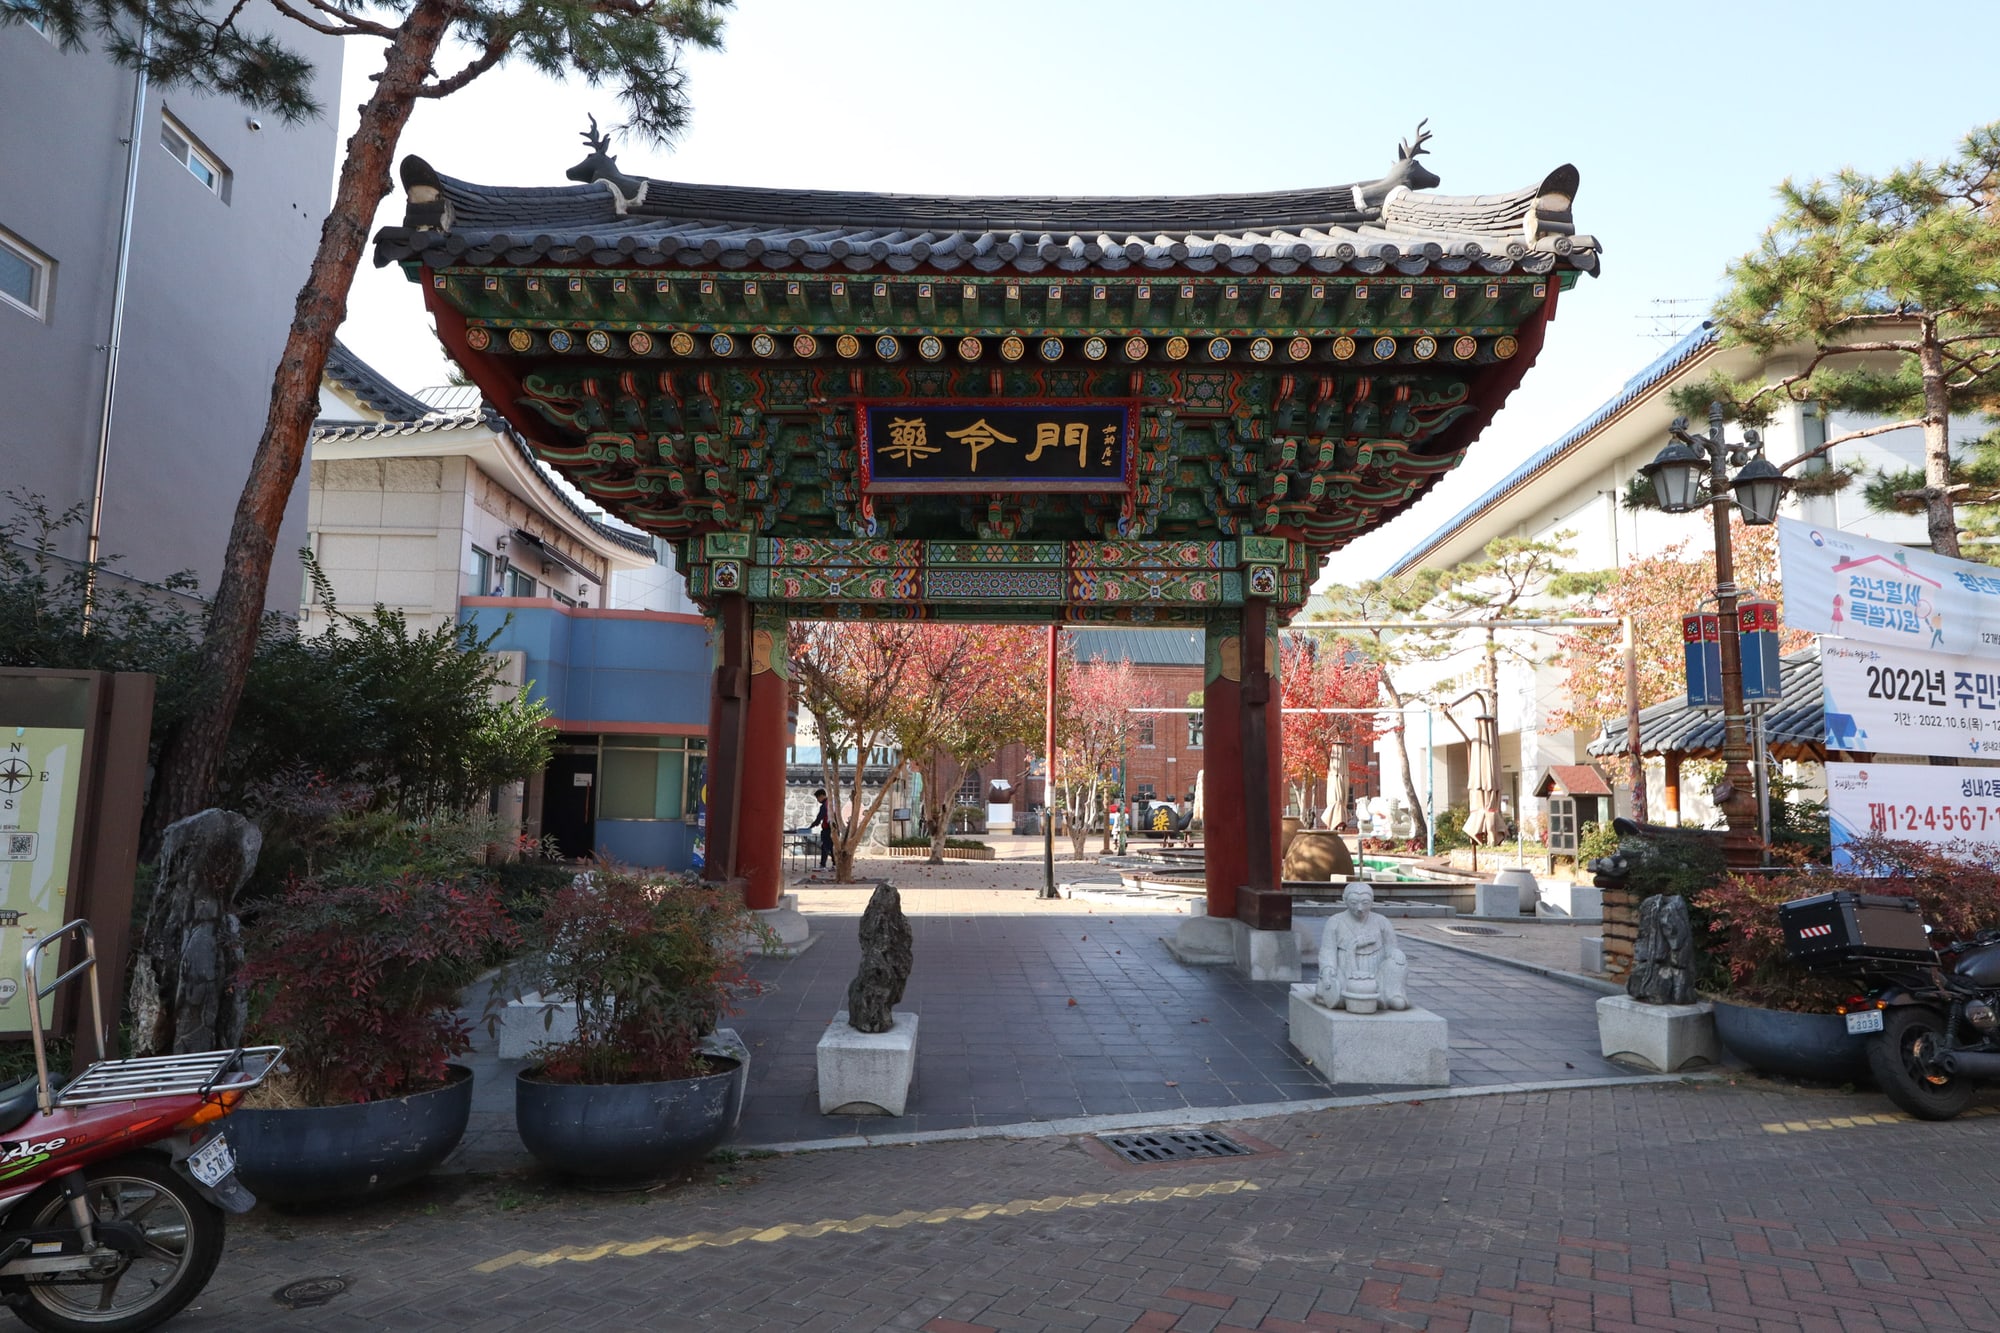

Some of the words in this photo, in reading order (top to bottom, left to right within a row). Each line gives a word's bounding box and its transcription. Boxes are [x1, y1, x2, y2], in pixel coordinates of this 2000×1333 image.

[876, 417, 1090, 472] 藥令門
[1849, 575, 1921, 606] 청년월세
[1849, 601, 1920, 634] 특별지원
[1866, 665, 1947, 706] 2022년
[1954, 671, 2000, 710] 주민
[1893, 712, 1911, 727] 기간
[10, 742, 21, 753] N
[1982, 740, 2000, 752] 성내2
[40, 771, 49, 782] E
[4, 799, 13, 810] S
[1857, 1018, 1879, 1030] 3038
